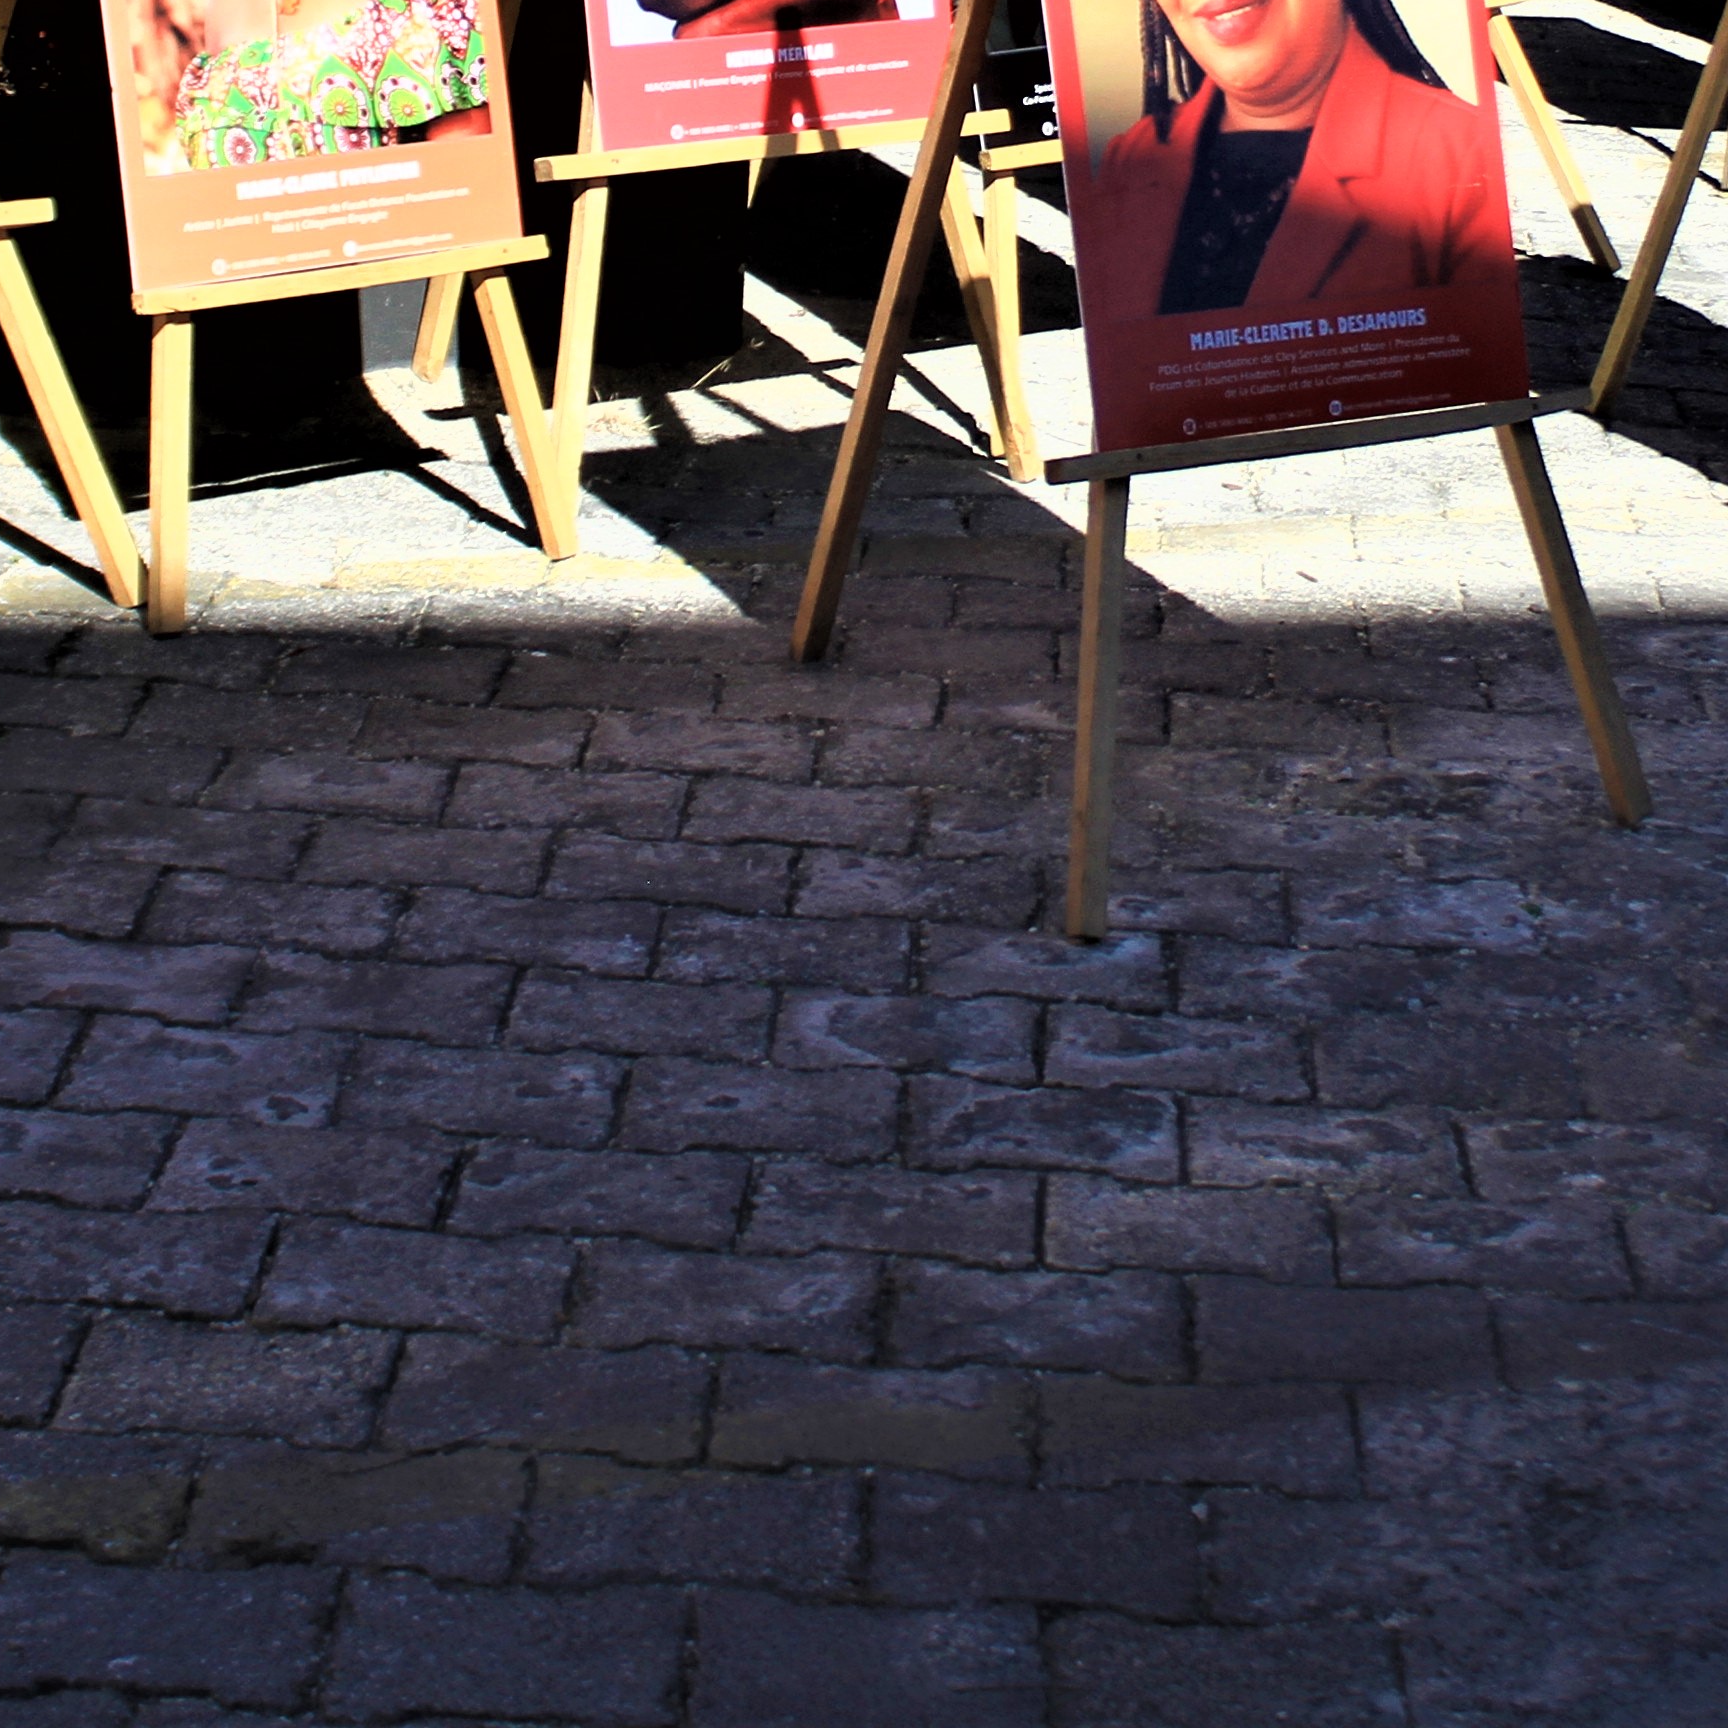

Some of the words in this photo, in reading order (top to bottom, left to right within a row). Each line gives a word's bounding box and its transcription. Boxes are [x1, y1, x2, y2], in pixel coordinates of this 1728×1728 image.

[1189, 320, 1314, 351] MARIE-CLERETTE
[1318, 318, 1334, 336] D.
[1337, 308, 1427, 334] DESAMOURS
